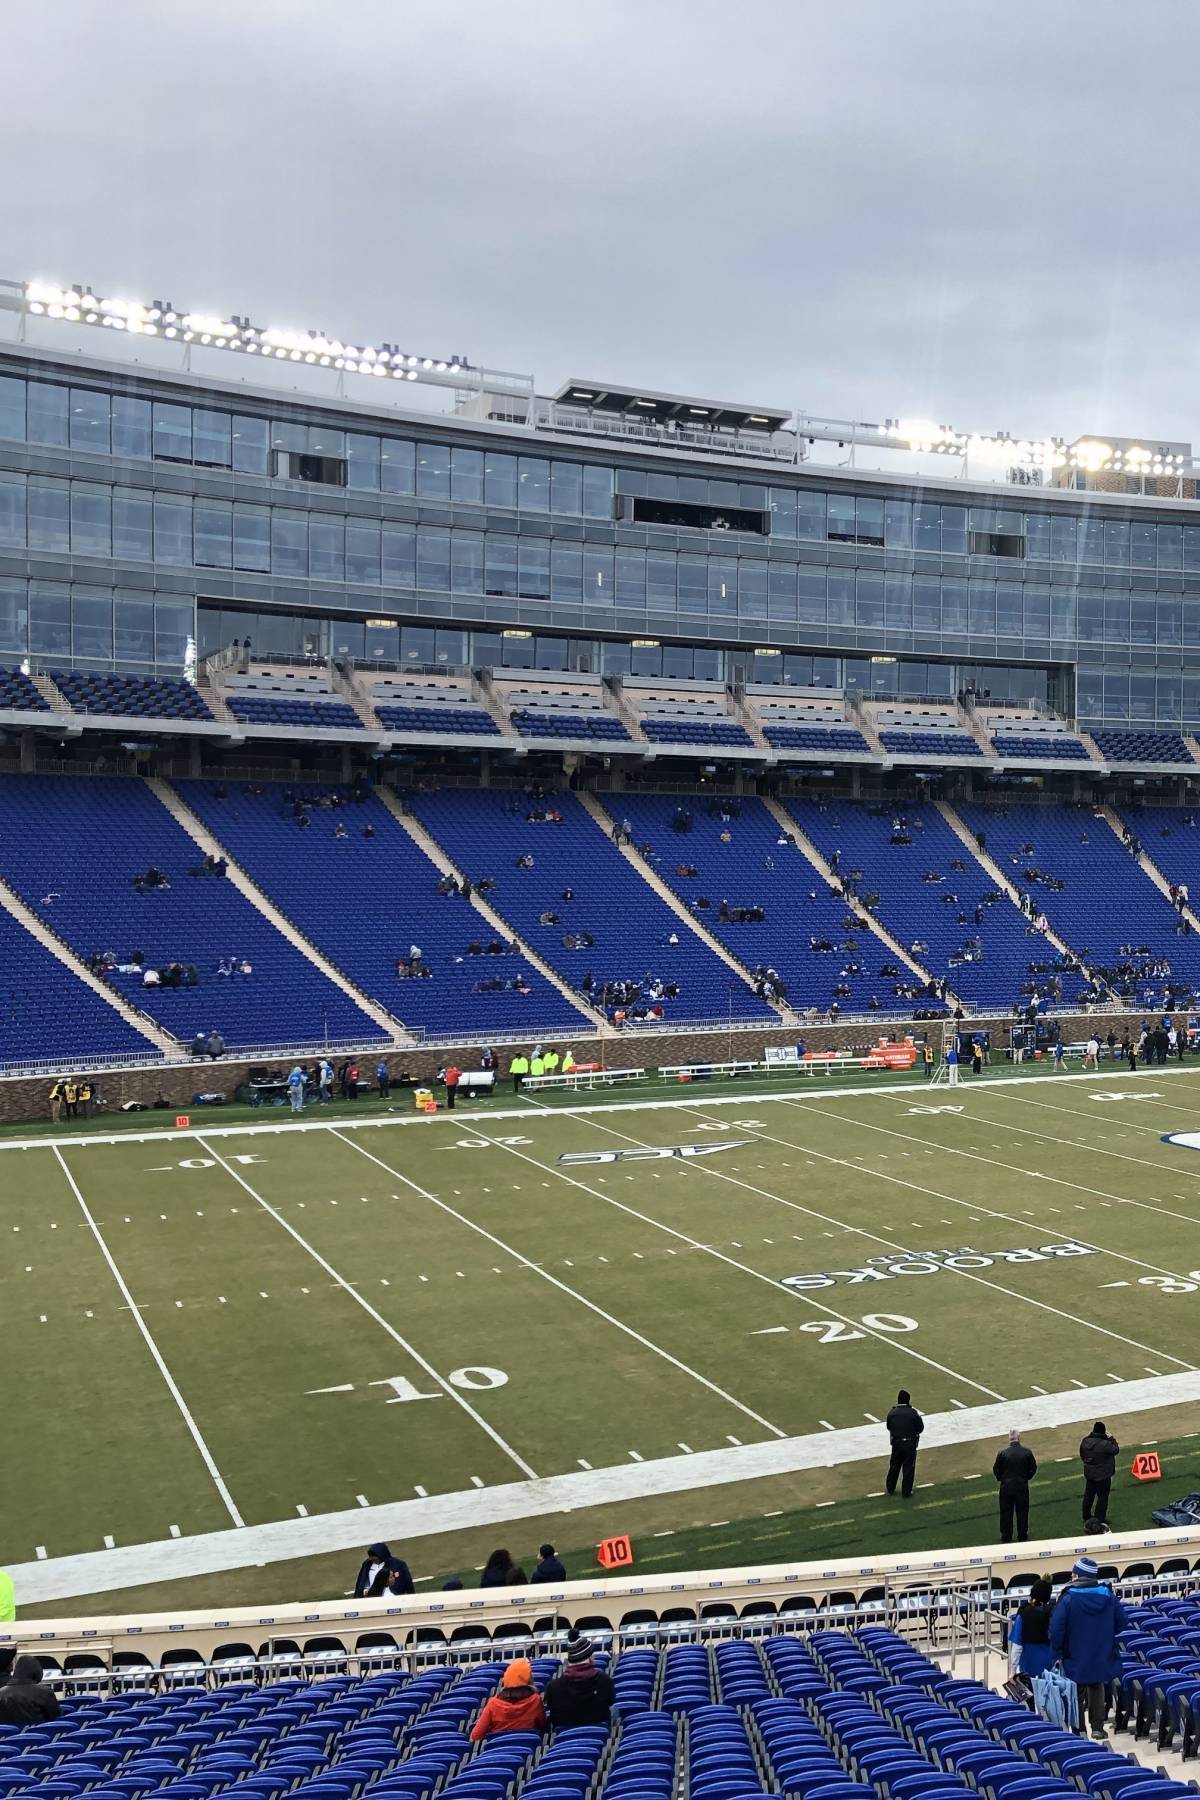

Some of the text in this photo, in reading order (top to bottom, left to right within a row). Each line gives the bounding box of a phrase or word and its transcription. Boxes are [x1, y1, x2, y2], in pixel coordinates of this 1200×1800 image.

[178, 1117, 188, 1126] 10
[556, 1138, 763, 1167] ACC
[779, 1242, 1101, 1290] BROOKS
[864, 1246, 985, 1265] FIELD
[799, 1313, 919, 1344] 20
[367, 1366, 510, 1404] 10
[1138, 1455, 1159, 1475] 20
[607, 1539, 628, 1563] 10
